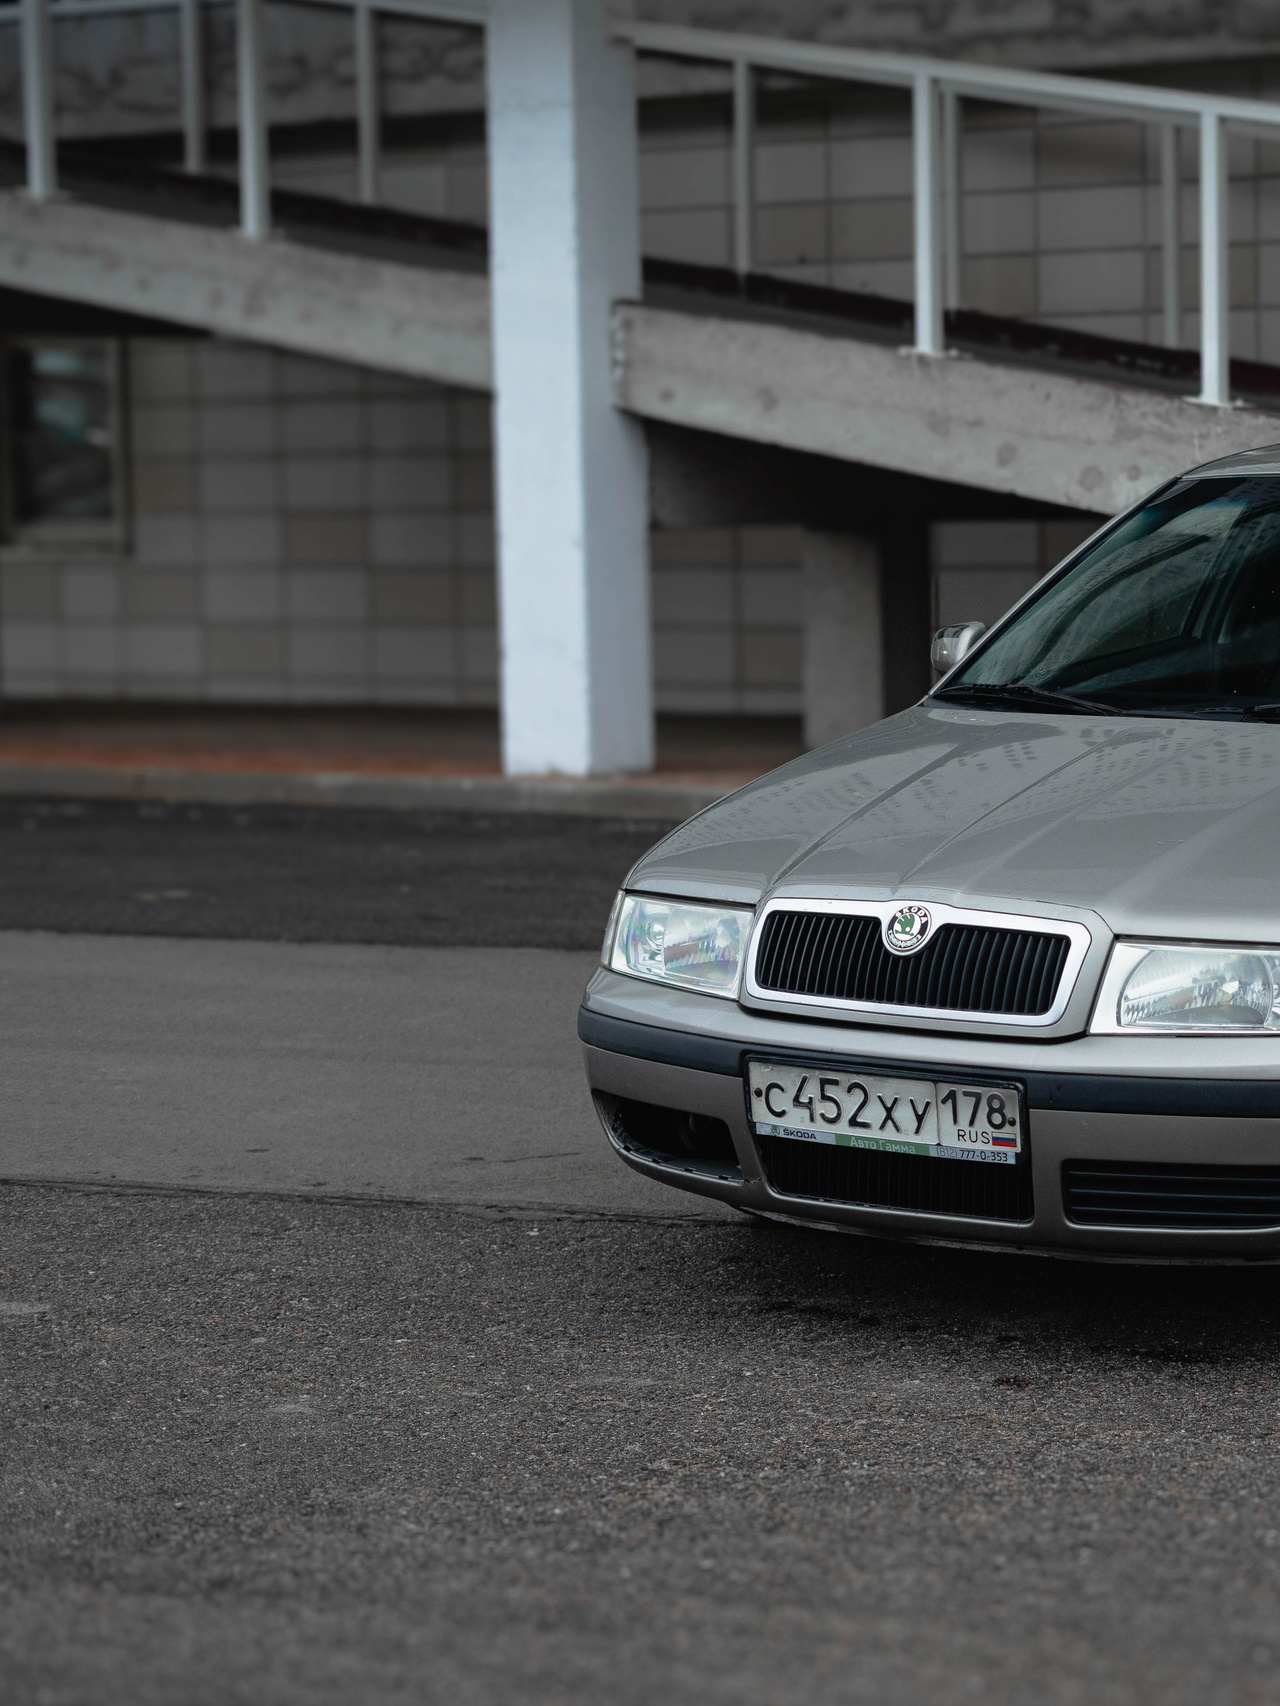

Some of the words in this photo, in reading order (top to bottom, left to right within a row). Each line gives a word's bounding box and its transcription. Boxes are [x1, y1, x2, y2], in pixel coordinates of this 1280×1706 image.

[941, 1088, 1008, 1131] 178
[957, 1129, 990, 1145] RUS
[959, 1149, 1008, 1162] 777-0-353
